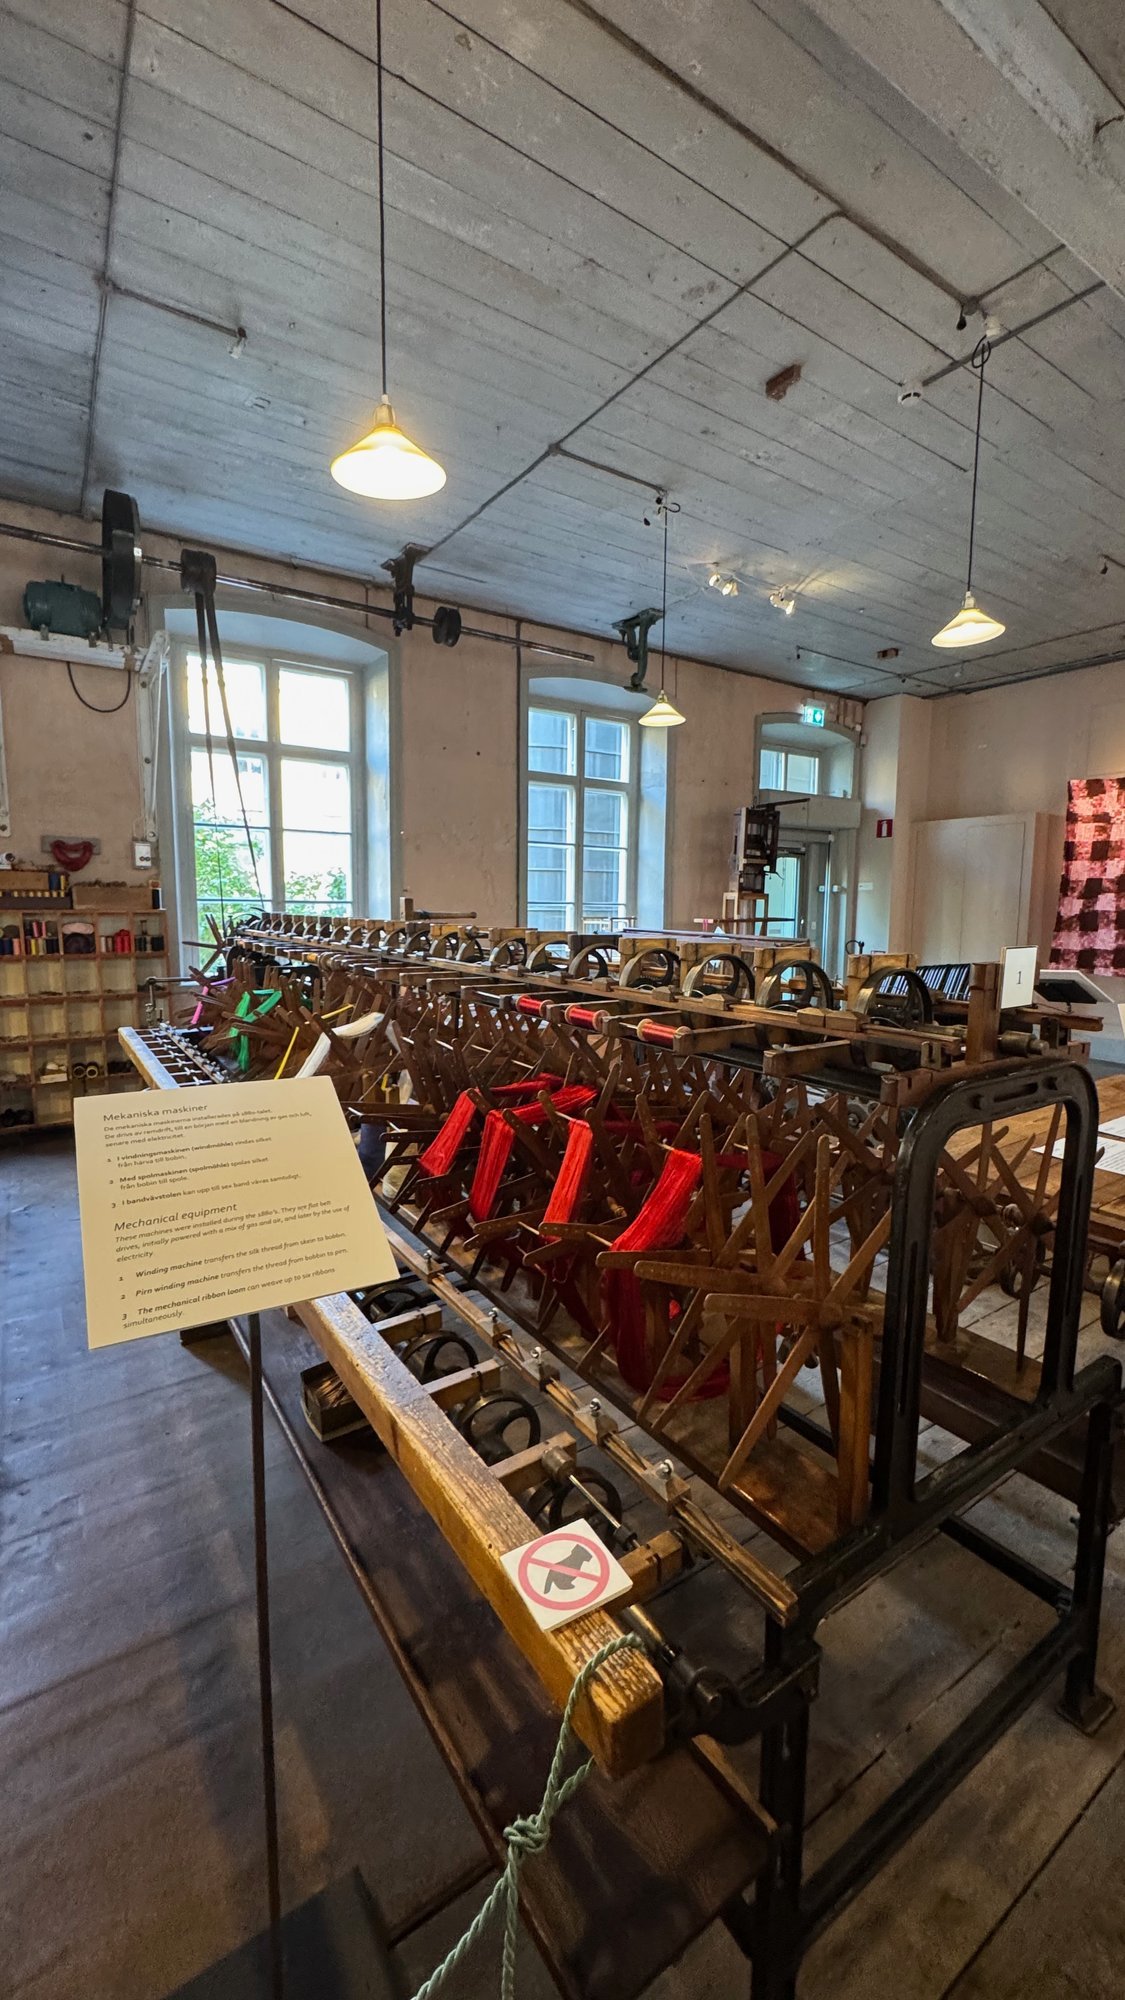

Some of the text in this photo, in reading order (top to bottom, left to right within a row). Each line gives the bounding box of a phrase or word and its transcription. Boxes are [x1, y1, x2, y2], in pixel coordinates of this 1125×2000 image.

[1016, 970, 1021, 984] 1
[104, 1105, 207, 1121] Mekaniska maskiner
[192, 1112, 231, 1121] installerades
[121, 1147, 190, 1160] vindningsmaskinen
[138, 1169, 187, 1180] spolmaskinen
[126, 1192, 181, 1205] bandvävstolen
[114, 1204, 237, 1231] Mechanical equipment
[116, 1234, 137, 1242] These
[139, 1228, 173, 1238] machines
[193, 1219, 221, 1228] installed
[308, 1202, 318, 1210] flat
[143, 1238, 170, 1247] initially
[170, 1232, 200, 1243] powered
[136, 1267, 168, 1278] Winding
[170, 1260, 202, 1271] machine
[204, 1253, 234, 1264] transfers
[261, 1243, 282, 1252] thread
[284, 1241, 299, 1250] from
[325, 1232, 346, 1240] bobbin.
[154, 1281, 186, 1292] winding
[187, 1274, 219, 1285] machine
[221, 1268, 251, 1278] transfers
[266, 1260, 287, 1269] thread
[288, 1257, 303, 1266] from
[305, 1253, 326, 1261] bobbin
[155, 1296, 200, 1311] mechanical
[202, 1291, 225, 1301] ribbon
[228, 1287, 246, 1295] loom
[261, 1279, 283, 1288] weave
[312, 1268, 335, 1277] ribbons
[123, 1310, 183, 1328] simultaneously.
